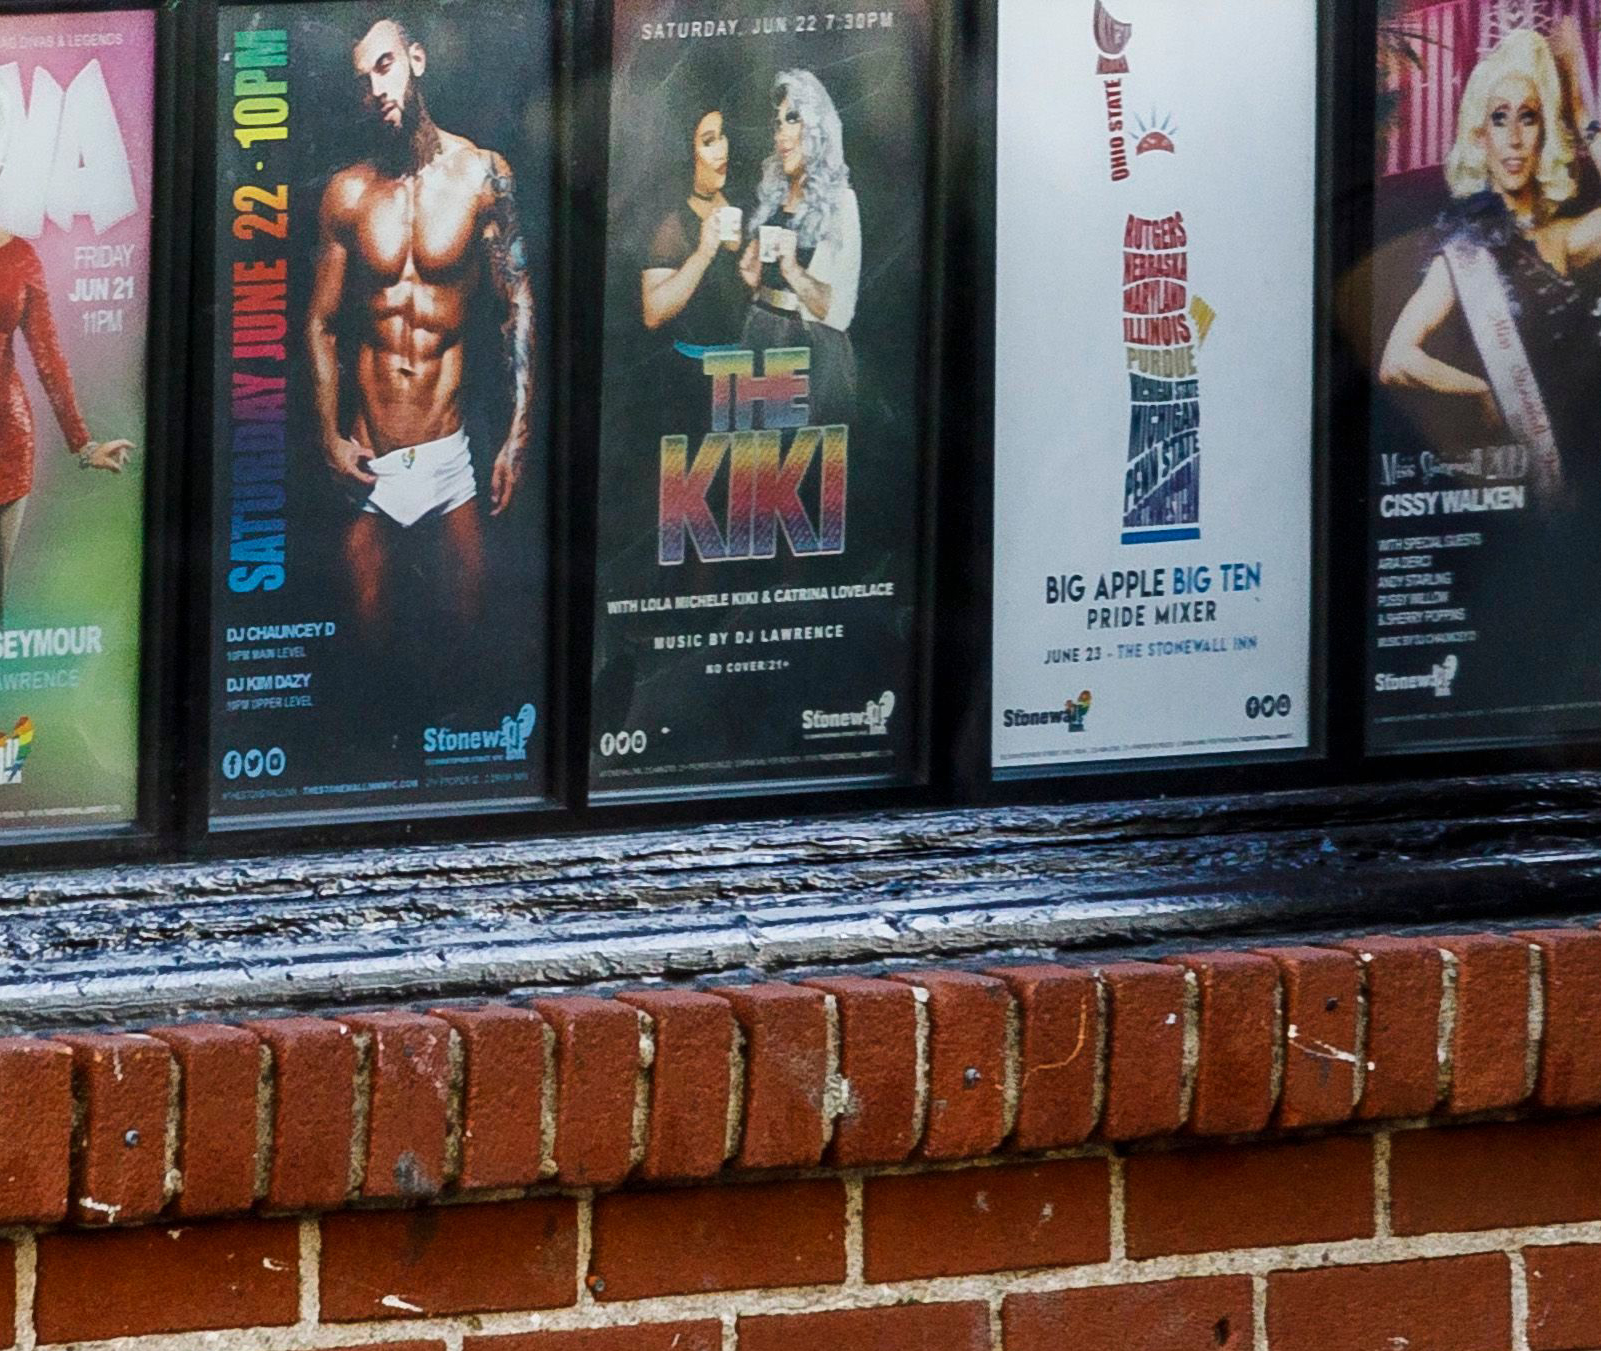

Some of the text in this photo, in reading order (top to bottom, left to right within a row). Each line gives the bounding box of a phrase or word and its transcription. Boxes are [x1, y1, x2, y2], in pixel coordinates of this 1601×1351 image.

[68, 33, 124, 47] LEGENDS
[641, 11, 894, 41] SATURDAY, JUN 22 7:30PM
[1104, 78, 1130, 182] OHIO STATE
[1123, 211, 1187, 250] RUTGERS
[74, 244, 135, 270] FRIDAY
[69, 277, 134, 303] JUN 21
[82, 308, 123, 335] 11PM
[227, 28, 290, 594] SATURDAY JUNE 22 10PM
[1123, 314, 1191, 346] ILLINOIS
[1126, 345, 1199, 378] PURDUE
[702, 346, 811, 432] THE
[657, 424, 849, 566] KIKI
[1380, 486, 1525, 517] CISSY WALKEN
[1046, 562, 1261, 604] BIG APPLE BIG TEN
[607, 582, 894, 615] WITH LOLA MICHELE KIKI & CATRINA LOVELACE
[1087, 601, 1217, 630] PRIDE MIXER
[226, 622, 335, 642] DJ CHAUNCEY D
[654, 624, 844, 650] MUSIC BY DJ LAWRENCE
[1044, 635, 1258, 665] JUNE 23 THE STONEWALL INN
[705, 662, 723, 674] NO
[726, 660, 765, 674] COVER
[226, 673, 312, 692] DJ KIM DAZY
